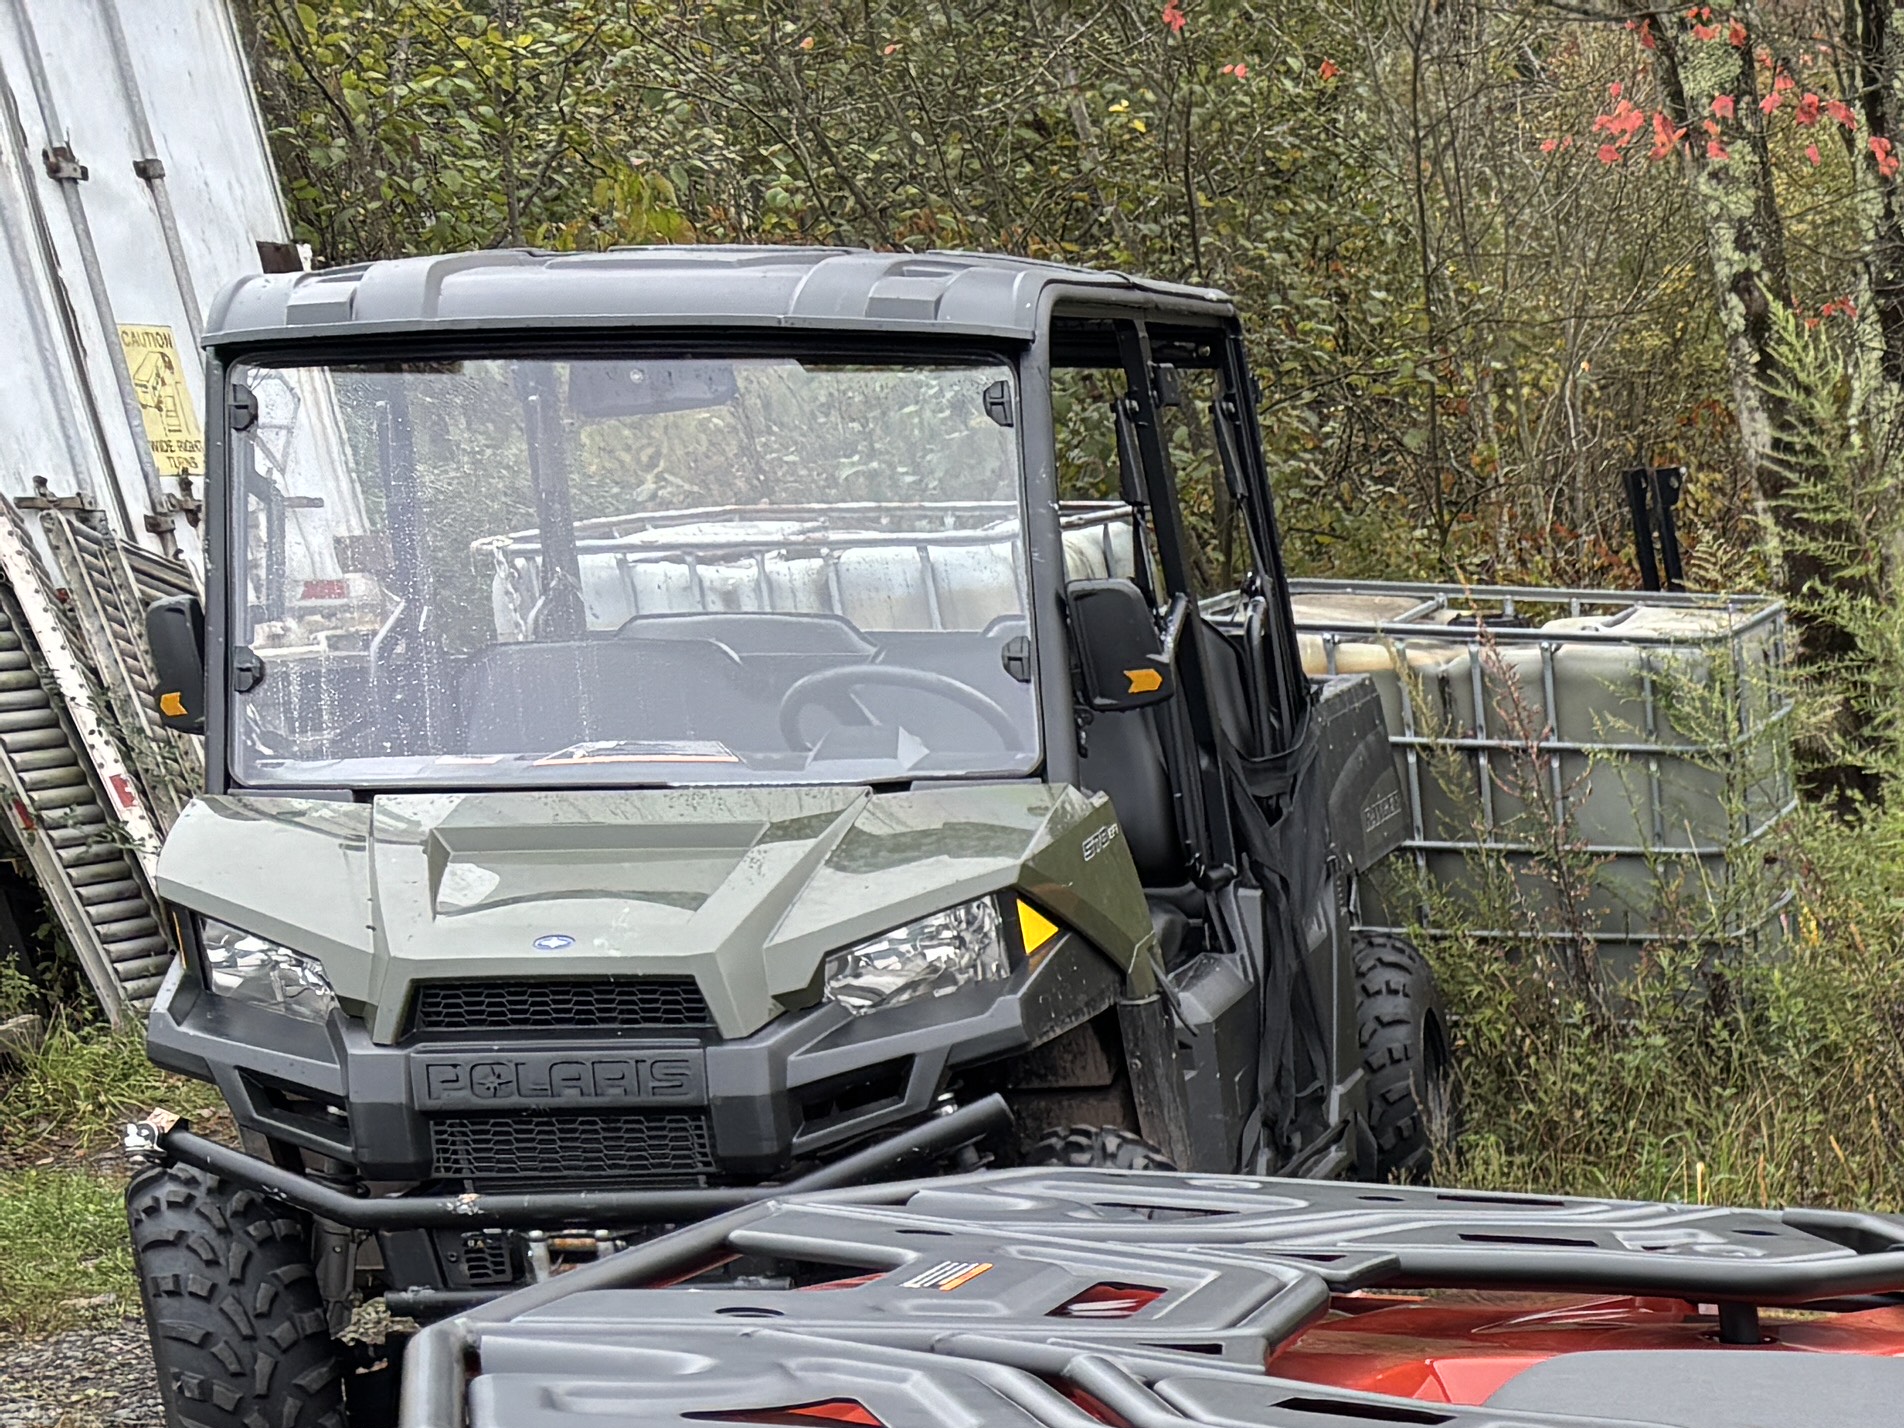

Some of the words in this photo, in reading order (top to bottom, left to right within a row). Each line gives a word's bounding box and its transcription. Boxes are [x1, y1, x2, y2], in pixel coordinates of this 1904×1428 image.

[120, 331, 174, 349] CAUTION
[151, 440, 176, 453] WIDE
[425, 1059, 692, 1101] POLARIS
